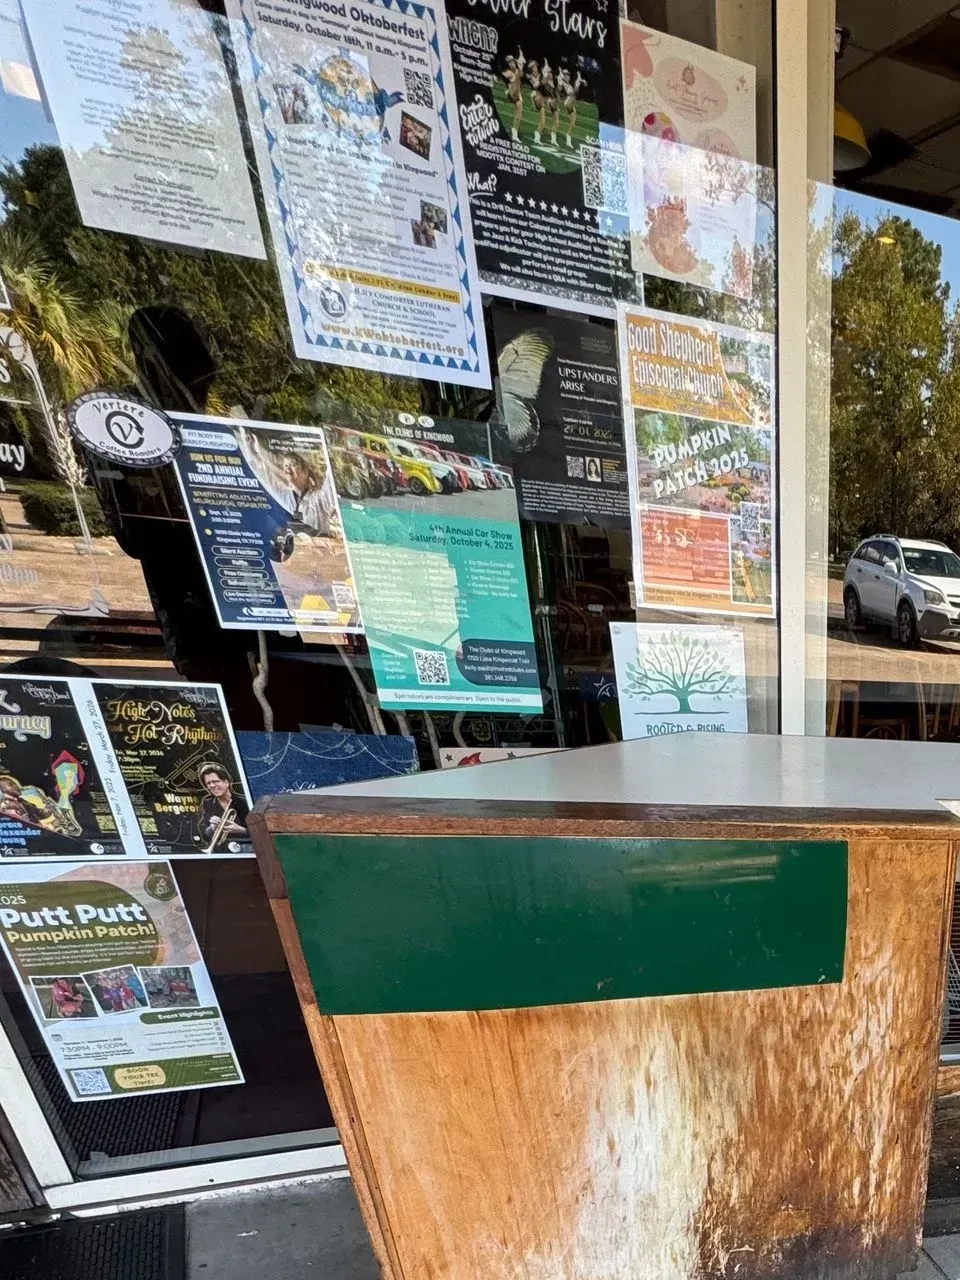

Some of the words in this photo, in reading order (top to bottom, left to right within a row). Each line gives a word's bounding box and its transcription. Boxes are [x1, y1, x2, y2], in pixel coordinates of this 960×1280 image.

[350, 6, 425, 40] Oktoberfest
[545, 0, 608, 47] Stars
[258, 12, 303, 31] Saturday,
[306, 24, 342, 41] October
[344, 35, 364, 49] 18th,
[401, 51, 406, 59] 5
[409, 54, 428, 66] p.m.
[453, 44, 481, 58] October
[460, 94, 493, 130] Enter
[480, 143, 526, 161] REGISTRATION
[526, 153, 540, 164] FOR
[495, 139, 510, 148] FREE
[511, 143, 529, 153] SOLO
[497, 164, 512, 173] JAN.
[505, 156, 534, 170] CONTEST
[535, 165, 545, 173] ON
[467, 173, 497, 192] What?
[491, 203, 504, 212] Drill
[505, 206, 524, 216] Dance
[524, 211, 541, 220] Team
[542, 214, 564, 225] Audition
[565, 220, 585, 230] Master
[474, 220, 498, 230] prepare
[521, 231, 534, 239] your
[535, 232, 547, 242] High
[549, 237, 566, 246] School
[502, 215, 517, 224] from
[559, 229, 581, 239] Audition
[510, 237, 522, 245] Kick
[523, 240, 551, 253] Technique
[522, 259, 545, 270] perform
[552, 265, 566, 274] small
[566, 258, 589, 270] personal
[372, 300, 401, 312] CHURCH
[410, 307, 436, 318] SCHOOL
[374, 292, 415, 304] COMFORTER
[416, 300, 450, 312] LUTHERAN
[628, 323, 657, 353] Good
[660, 323, 715, 368] Shepherd
[558, 367, 618, 385] UPSTANDERS
[632, 356, 686, 392] Episcopal
[687, 368, 724, 396] Church
[560, 380, 585, 392] ARISE
[92, 399, 145, 418] Vertere
[383, 425, 395, 435] THE
[395, 427, 414, 438] CLUBS
[423, 432, 454, 443] KINGWOOD
[99, 440, 128, 456] Coffee
[128, 447, 162, 458] Roasters
[650, 424, 732, 468] PUMPKIN
[204, 454, 214, 462] US
[214, 455, 226, 463] FOR
[196, 464, 213, 473] 2ND
[215, 465, 246, 477] ANNUAL
[653, 462, 708, 498] PATCH
[709, 449, 749, 474] 2025
[188, 472, 237, 486] FUNDRAISING
[238, 476, 259, 488] EVENT
[409, 532, 449, 546] Saturday,
[450, 537, 483, 548] October
[484, 540, 493, 550] 4,
[494, 541, 514, 550] 2025
[429, 524, 444, 533] 4th
[446, 527, 474, 536] Annual
[475, 529, 489, 538] Car
[490, 530, 513, 540] Show
[493, 657, 518, 665] Kingwood
[501, 648, 526, 657] Kingwood
[88, 700, 98, 718] 2026
[107, 700, 149, 721] High
[150, 700, 196, 722] Notes
[124, 724, 163, 744] Hot
[98, 733, 109, 754] March
[0, 896, 26, 905] 025
[0, 906, 74, 928] Putt
[75, 903, 148, 924] Putt
[6, 926, 94, 947] Pumpkin
[98, 924, 156, 938] Patch!
[179, 1010, 215, 1019] Highlights
